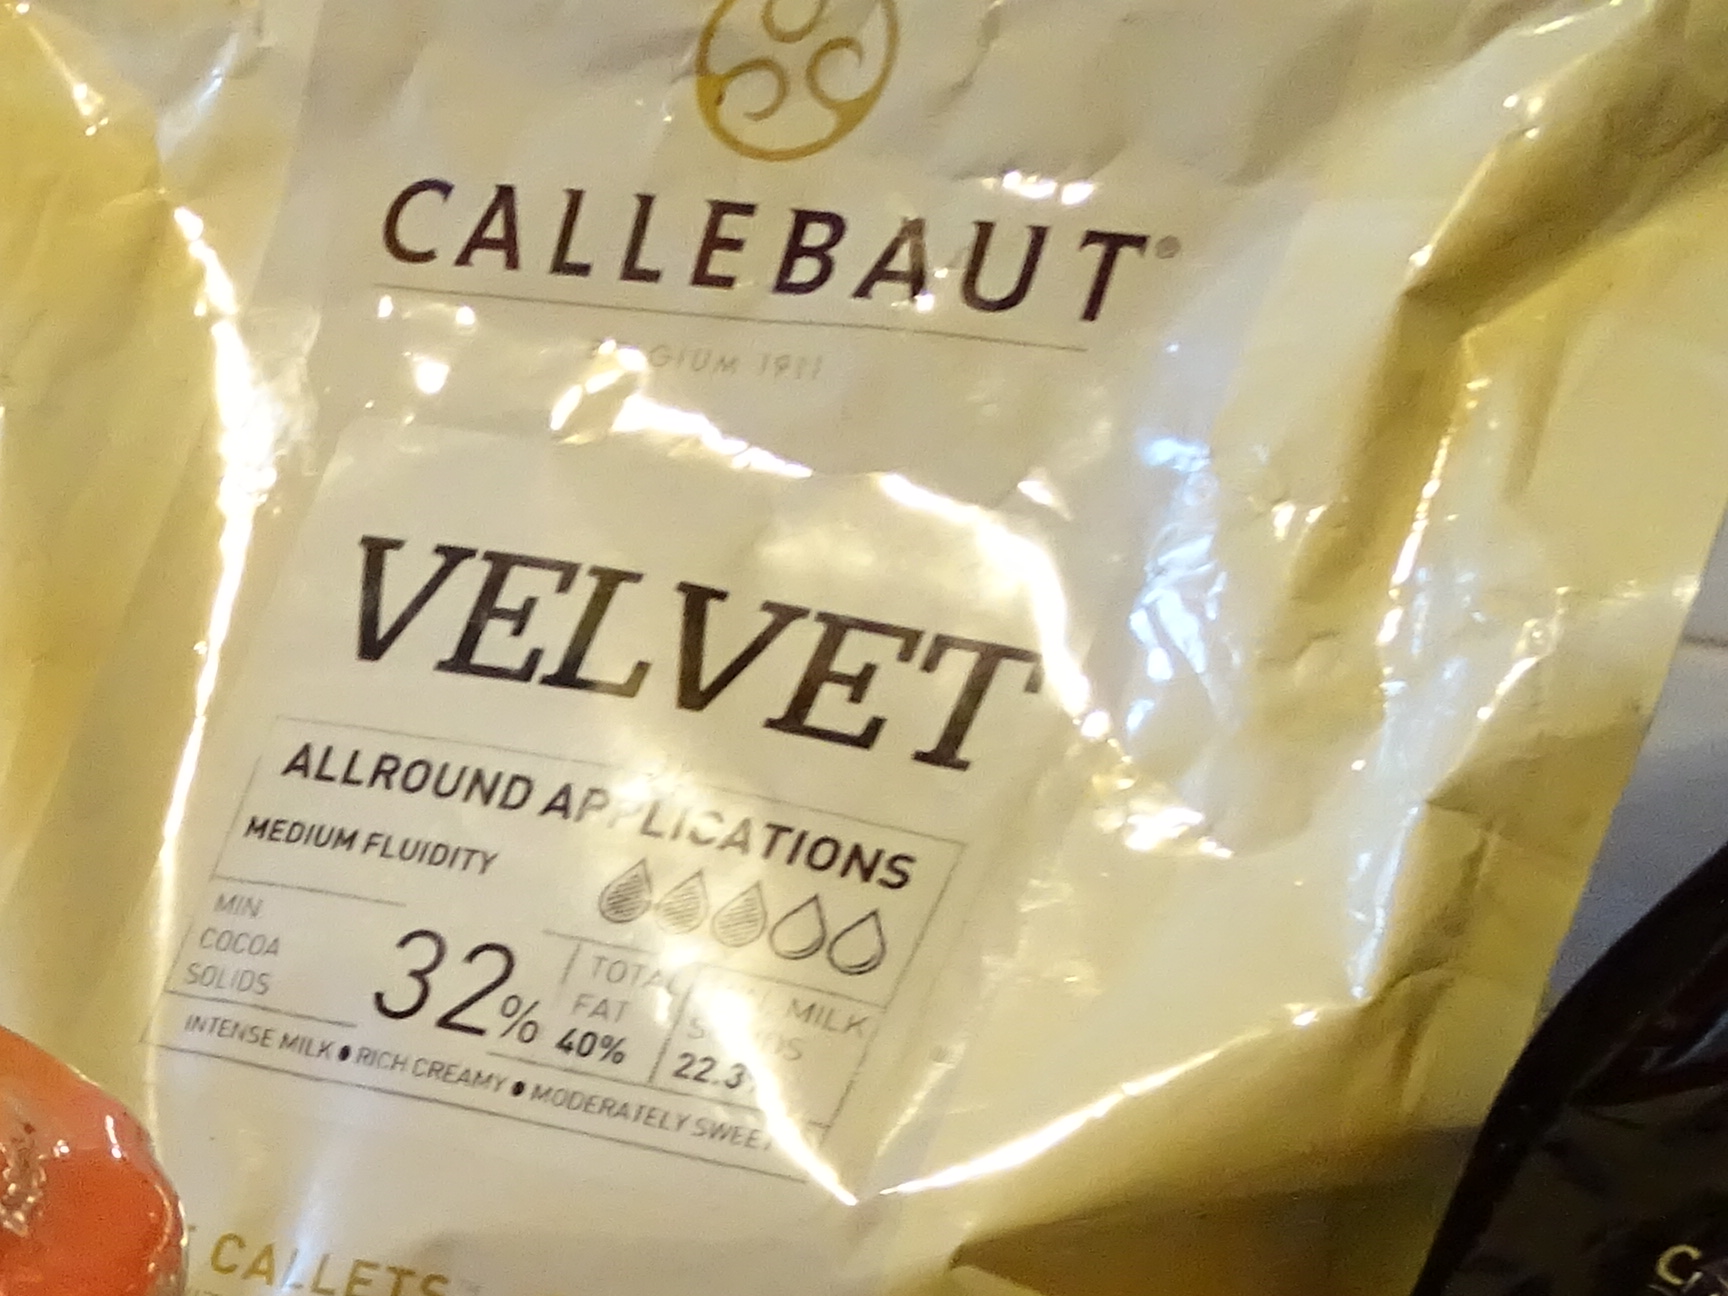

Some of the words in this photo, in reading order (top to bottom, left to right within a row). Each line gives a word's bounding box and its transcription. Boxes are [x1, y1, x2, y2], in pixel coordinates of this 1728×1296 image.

[352, 533, 1046, 773] VELVET
[280, 742, 535, 812] ALLROUND
[243, 815, 360, 852] MEDIUM
[362, 832, 499, 876] FLUIDITY
[212, 892, 264, 919] MIN
[199, 926, 281, 957] COCOA
[186, 962, 272, 996] SOLIDS
[591, 955, 681, 998] TOTAL
[569, 993, 629, 1024] FAT
[785, 997, 870, 1039] MILK
[554, 1027, 628, 1065] 40%
[184, 1014, 275, 1049] INTENSE
[279, 1034, 335, 1062] MILK
[355, 1046, 410, 1072] RICH
[411, 1057, 506, 1094] CREAMY
[529, 1085, 691, 1133] MODERATELY
[672, 1051, 756, 1093] 22.3
